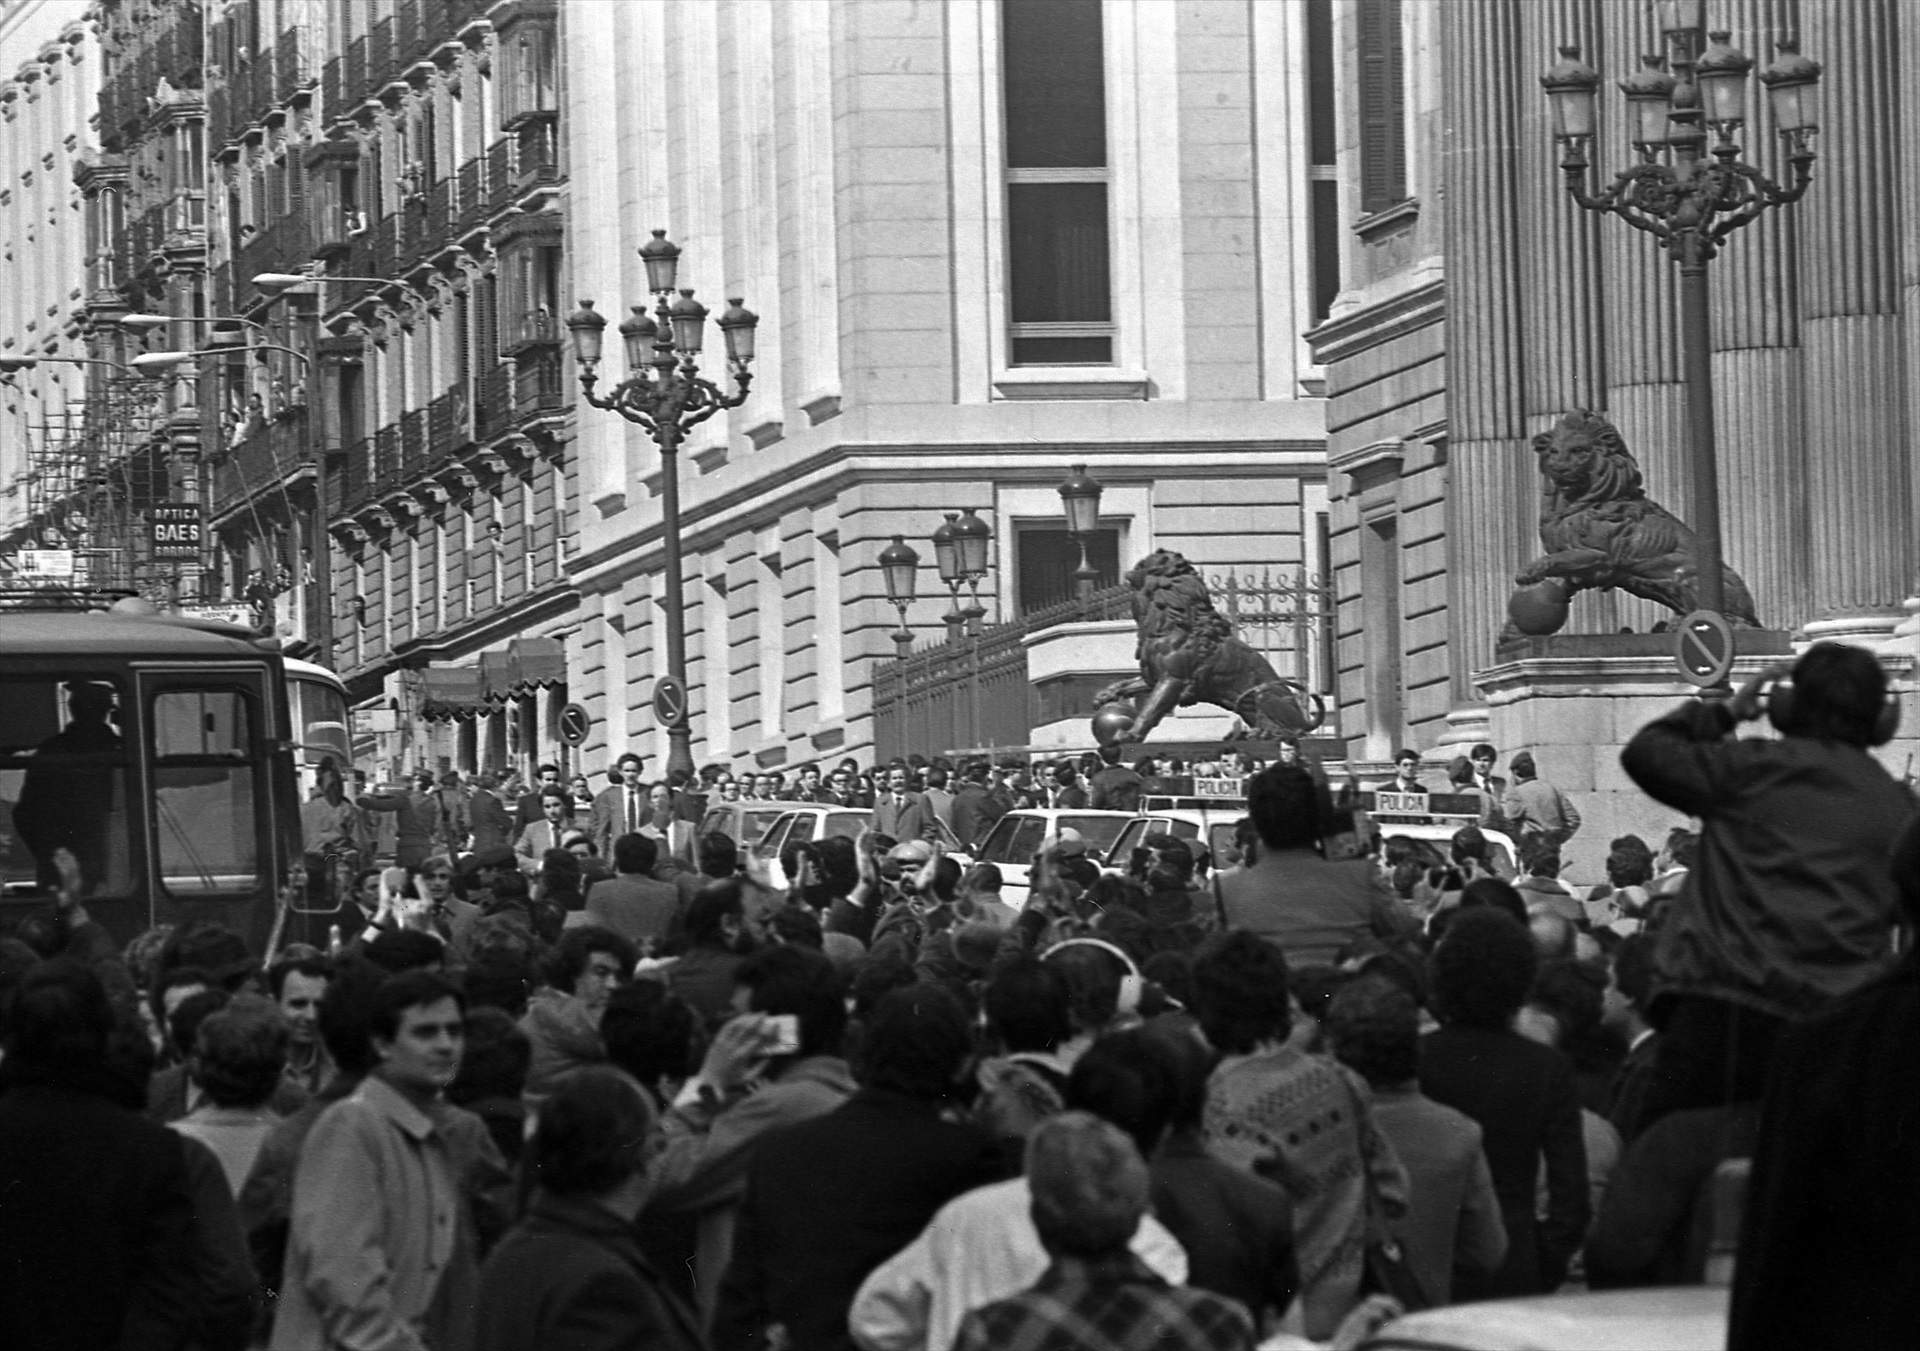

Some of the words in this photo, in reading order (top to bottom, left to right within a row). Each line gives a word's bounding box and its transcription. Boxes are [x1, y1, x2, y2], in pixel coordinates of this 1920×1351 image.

[155, 524, 200, 542] GAES
[1198, 780, 1238, 795] POLICIA
[1380, 794, 1424, 811] POLICIA
